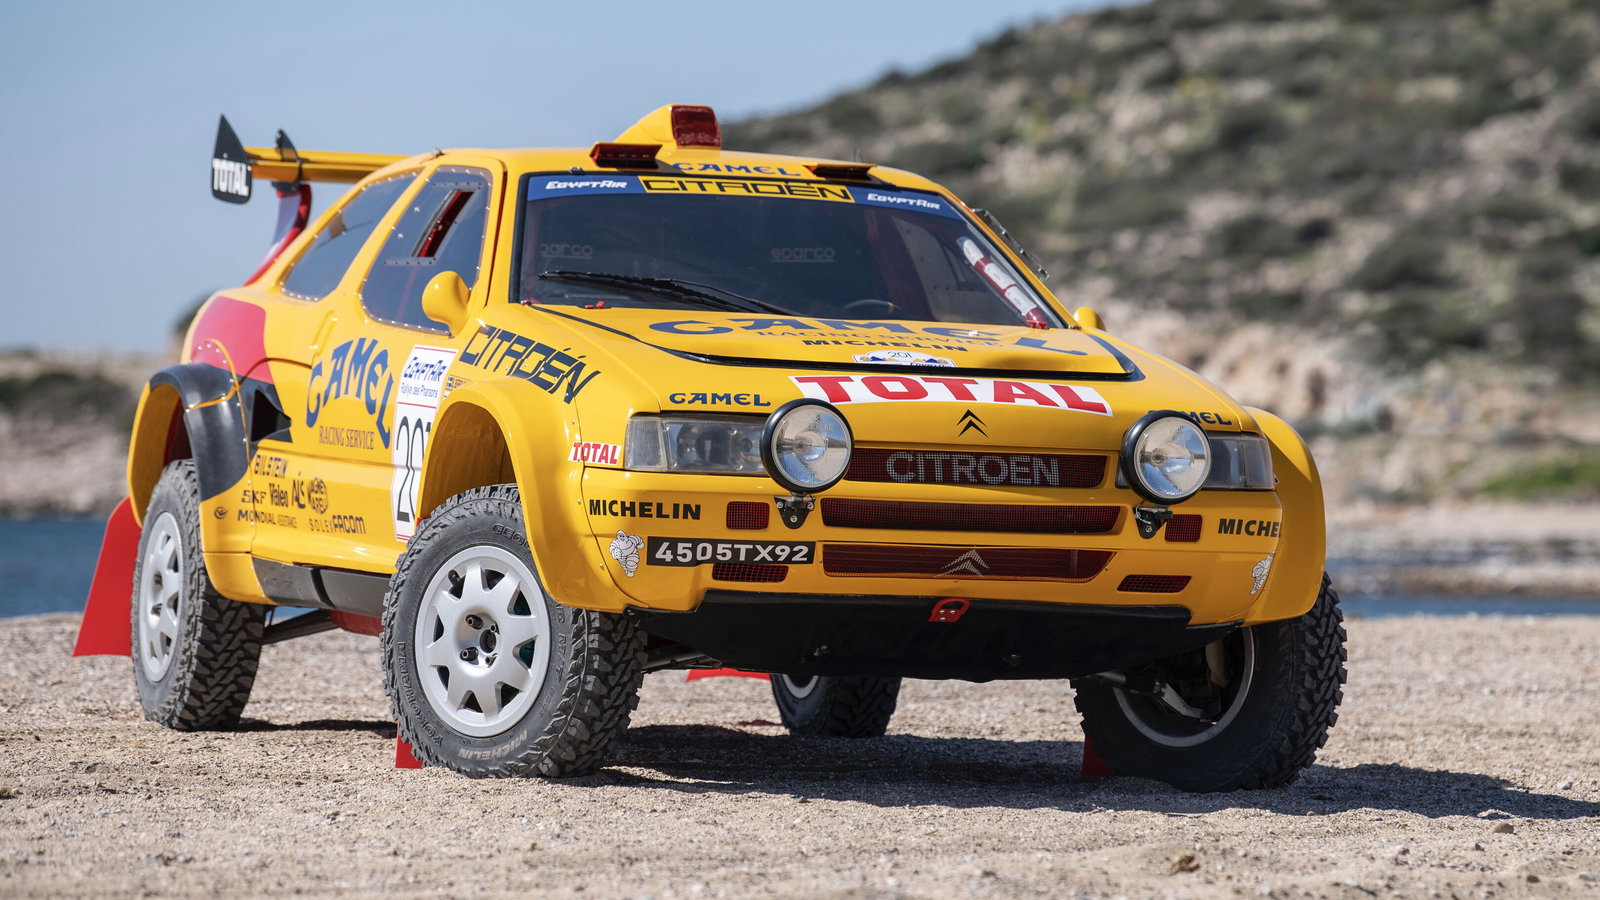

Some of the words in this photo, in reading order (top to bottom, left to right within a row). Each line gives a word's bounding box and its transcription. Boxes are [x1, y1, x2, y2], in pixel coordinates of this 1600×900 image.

[213, 158, 249, 197] TOTAL
[672, 162, 801, 176] CAMEL
[770, 246, 836, 261] sparco
[649, 318, 1089, 356] CAMEL
[802, 340, 968, 351] MICHELIN
[887, 351, 913, 359] 201
[306, 337, 394, 449] CAMEL
[669, 392, 772, 407] CAMEL
[793, 376, 1108, 414] TOTAL
[319, 425, 345, 447] RACING
[346, 428, 375, 450] SERVICE
[573, 442, 618, 465] TOTAL
[254, 454, 288, 478] BILSTEIN
[396, 415, 432, 523] 20
[885, 450, 1060, 487] CITROEN
[241, 489, 267, 505] SKF
[269, 482, 289, 508] Valeo
[237, 509, 276, 525] MONDIAL
[589, 499, 701, 520] MICHELIN
[654, 541, 809, 563] 4505TX92
[458, 729, 528, 761] MICHELIN
